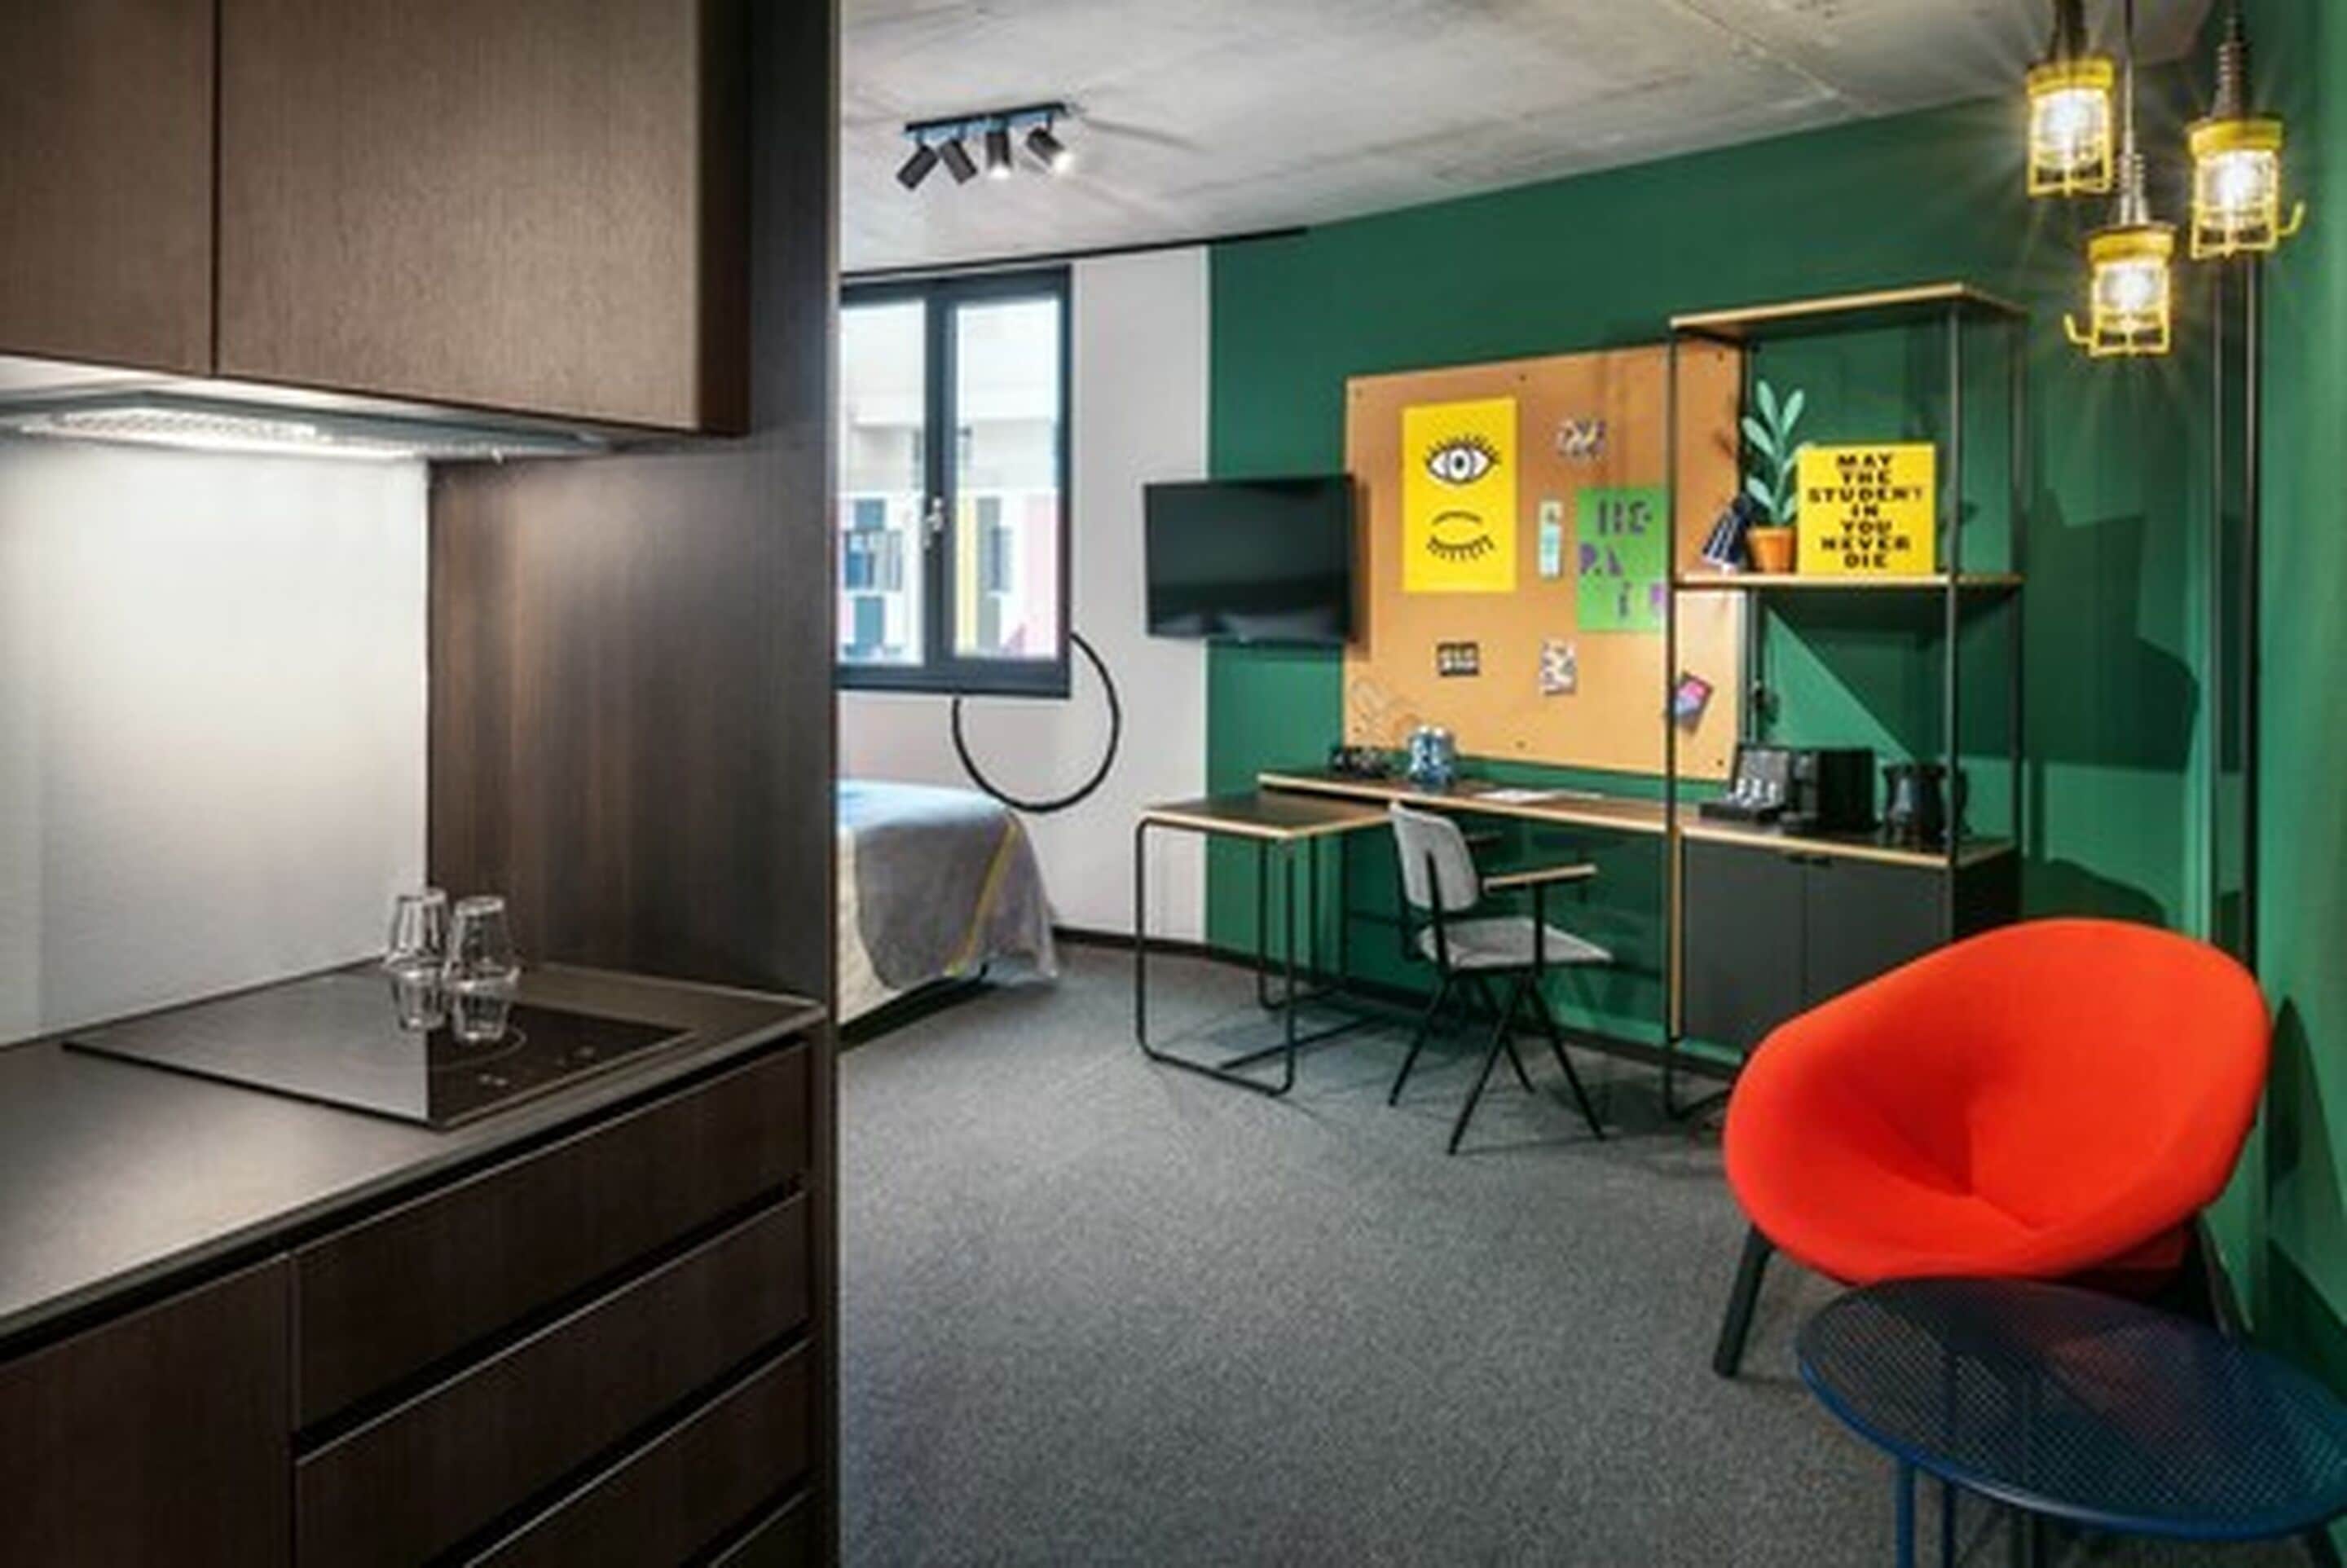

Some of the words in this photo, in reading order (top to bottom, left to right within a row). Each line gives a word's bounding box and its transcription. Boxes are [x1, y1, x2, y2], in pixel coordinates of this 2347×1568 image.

[1837, 453, 1893, 467] MAY
[1843, 471, 1891, 484] THE
[1809, 488, 1922, 502] STUDENT
[1852, 504, 1878, 518] IN
[1841, 521, 1892, 535] YOU
[1821, 536, 1909, 550] NEVER
[1844, 553, 1887, 568] DIE
